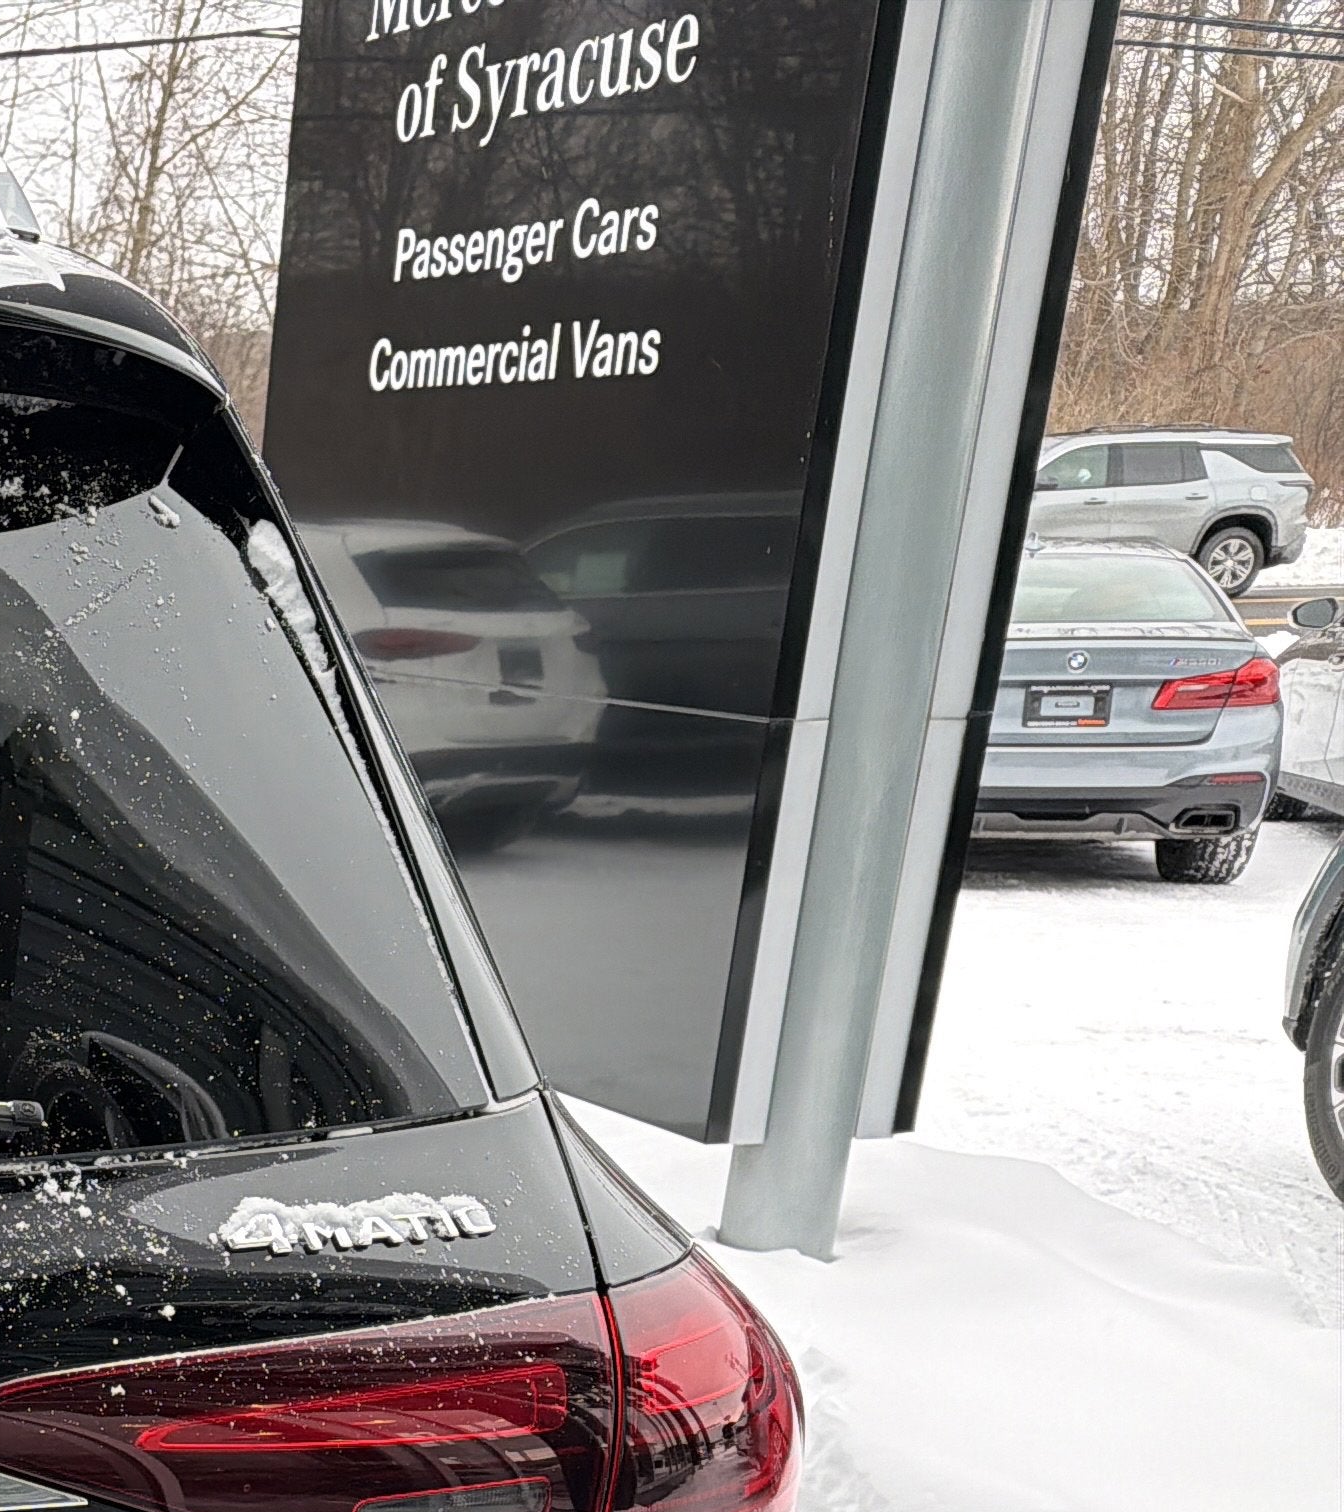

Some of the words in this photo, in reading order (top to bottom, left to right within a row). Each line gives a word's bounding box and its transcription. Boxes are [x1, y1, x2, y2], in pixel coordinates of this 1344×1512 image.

[396, 53, 448, 143] of
[450, 13, 700, 148] Syracuse
[393, 218, 565, 283] Passenger
[572, 197, 660, 259] Cars
[369, 322, 562, 392] Commercial
[572, 319, 662, 379] Vans
